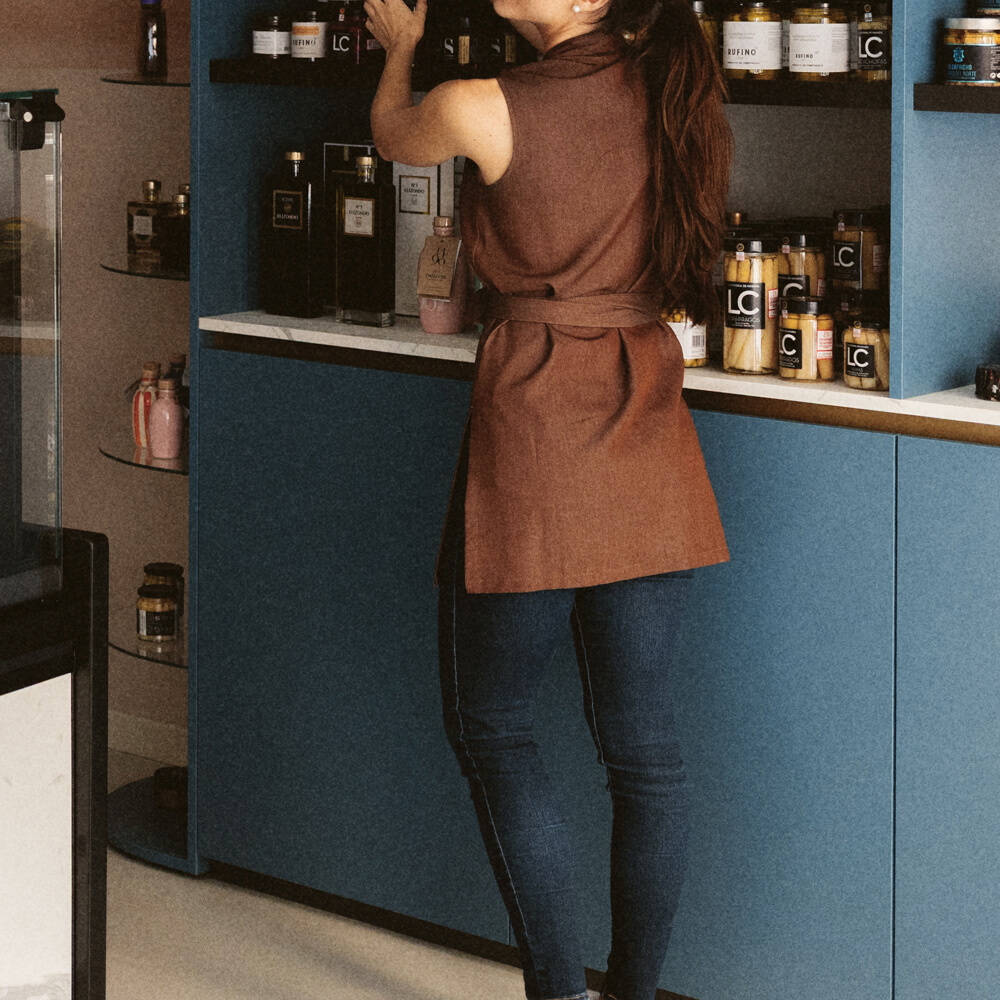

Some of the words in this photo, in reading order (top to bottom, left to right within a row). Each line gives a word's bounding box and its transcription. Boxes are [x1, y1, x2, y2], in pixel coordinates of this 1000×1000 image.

[332, 34, 350, 52] LC
[727, 48, 756, 56] RUFINO
[858, 36, 883, 59] LC
[832, 245, 855, 267] LC
[727, 288, 760, 315] LC
[847, 347, 869, 368] LC
